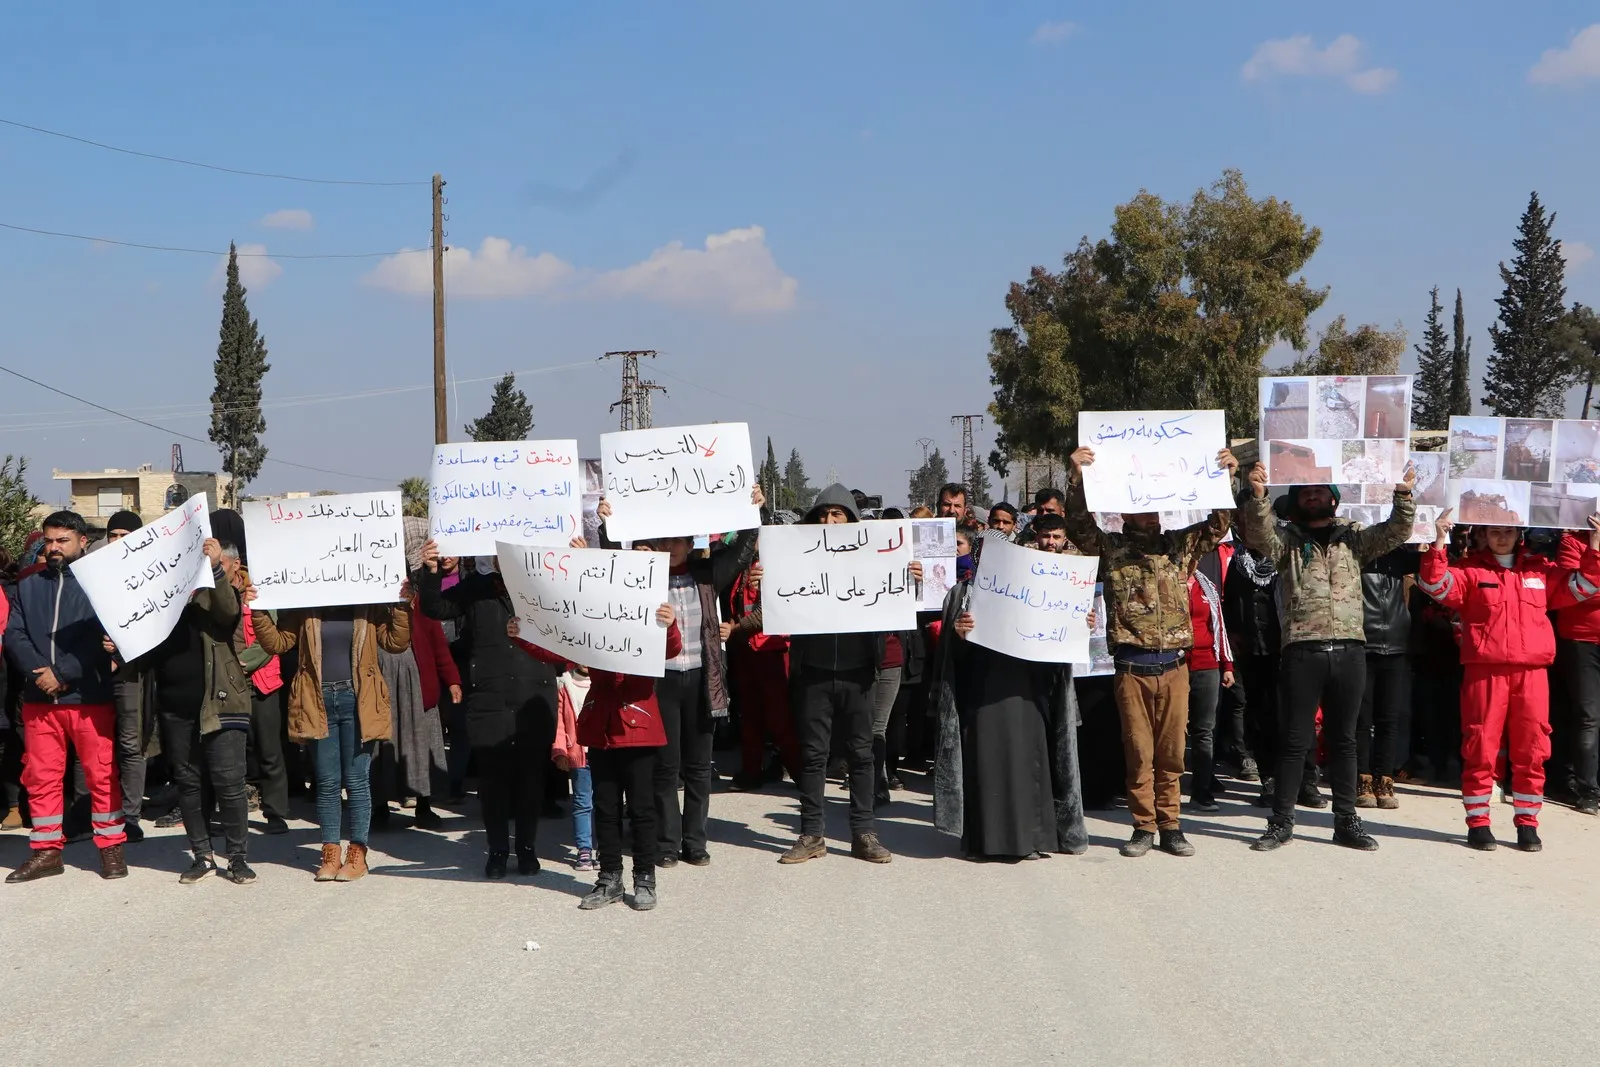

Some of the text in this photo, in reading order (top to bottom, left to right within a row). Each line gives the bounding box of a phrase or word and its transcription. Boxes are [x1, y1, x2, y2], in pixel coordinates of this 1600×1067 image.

[1089, 412, 1196, 445] حكومة دمشق
[437, 449, 572, 470] دمشق تمنع مساعدة
[614, 434, 718, 464] لا للتسييس
[432, 480, 571, 505] الشعب في المناطق المنكوبة
[608, 464, 746, 497] الأعمال الإنسانية
[353, 500, 396, 522] نطالب
[1129, 485, 1198, 507] في سوريا
[122, 527, 159, 560] الحصار
[319, 532, 398, 561] لفتح المعابر
[804, 527, 904, 558] لا للحصار
[124, 559, 168, 591] الكارثة
[169, 553, 181, 568] من
[290, 564, 346, 585] المساعدات
[578, 552, 618, 593] أنتم
[624, 557, 656, 589] أين
[252, 568, 288, 590] للشعب
[777, 567, 910, 607] الجائر على الشعب
[1031, 563, 1096, 589] كومة دمشق
[160, 590, 174, 608] على
[518, 592, 649, 626] المنظمات الإنسانية
[978, 575, 1090, 619] تمنع وصول المساعدات
[118, 598, 161, 629] الشعب
[525, 614, 591, 648] الديمقراطية
[1016, 626, 1067, 642] للشعب
